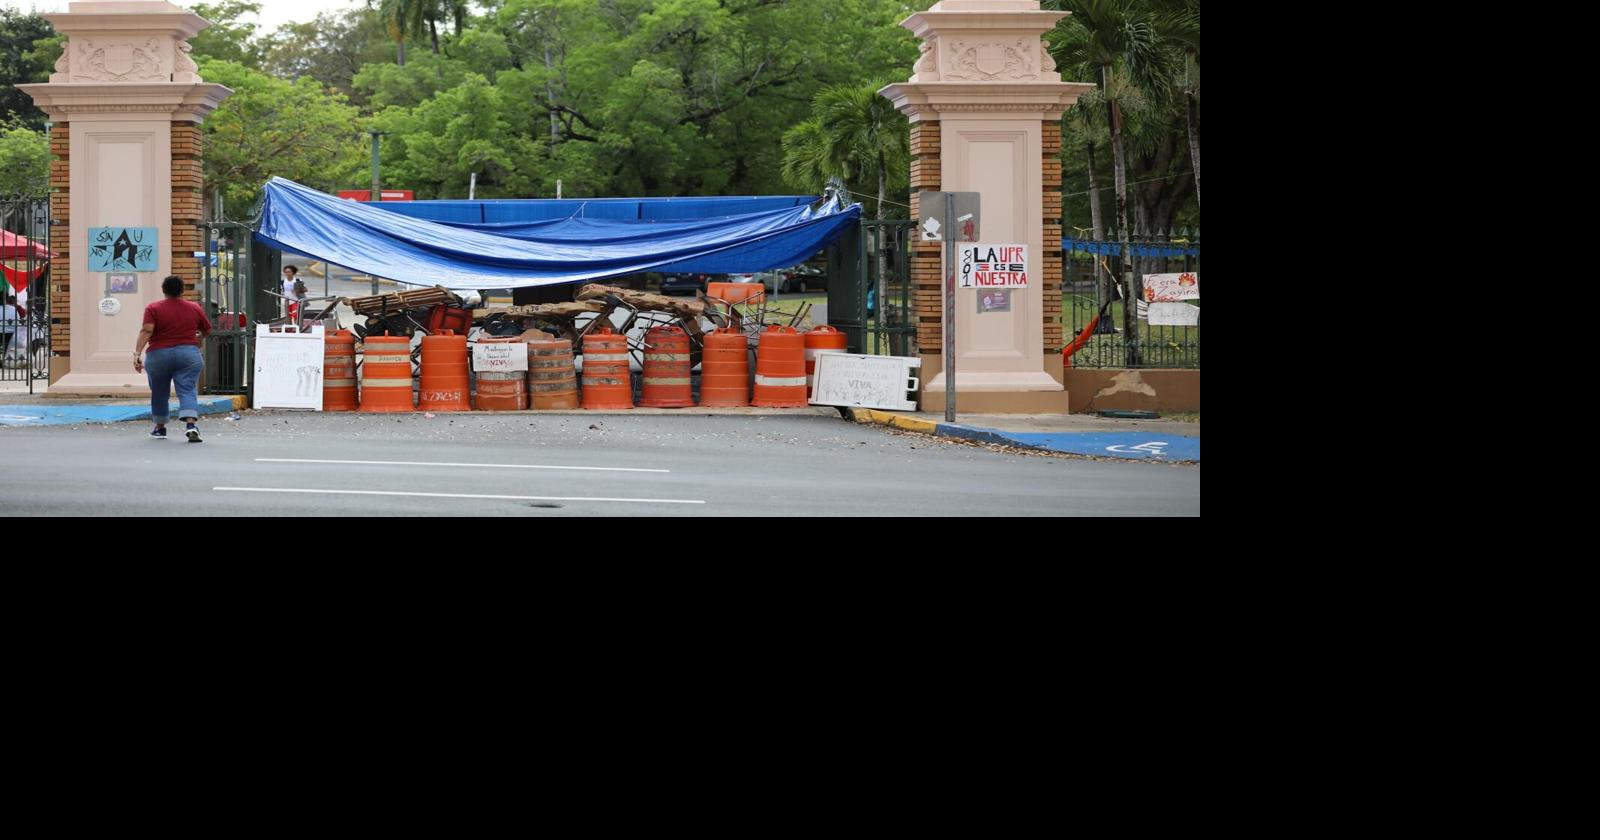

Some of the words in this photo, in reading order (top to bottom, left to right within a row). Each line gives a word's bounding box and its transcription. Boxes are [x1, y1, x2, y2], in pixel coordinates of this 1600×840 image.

[133, 229, 143, 243] U
[974, 247, 998, 263] LA
[1000, 247, 1024, 263] UPR
[975, 271, 1027, 287] NUESTRA
[848, 379, 873, 390] VIVA
